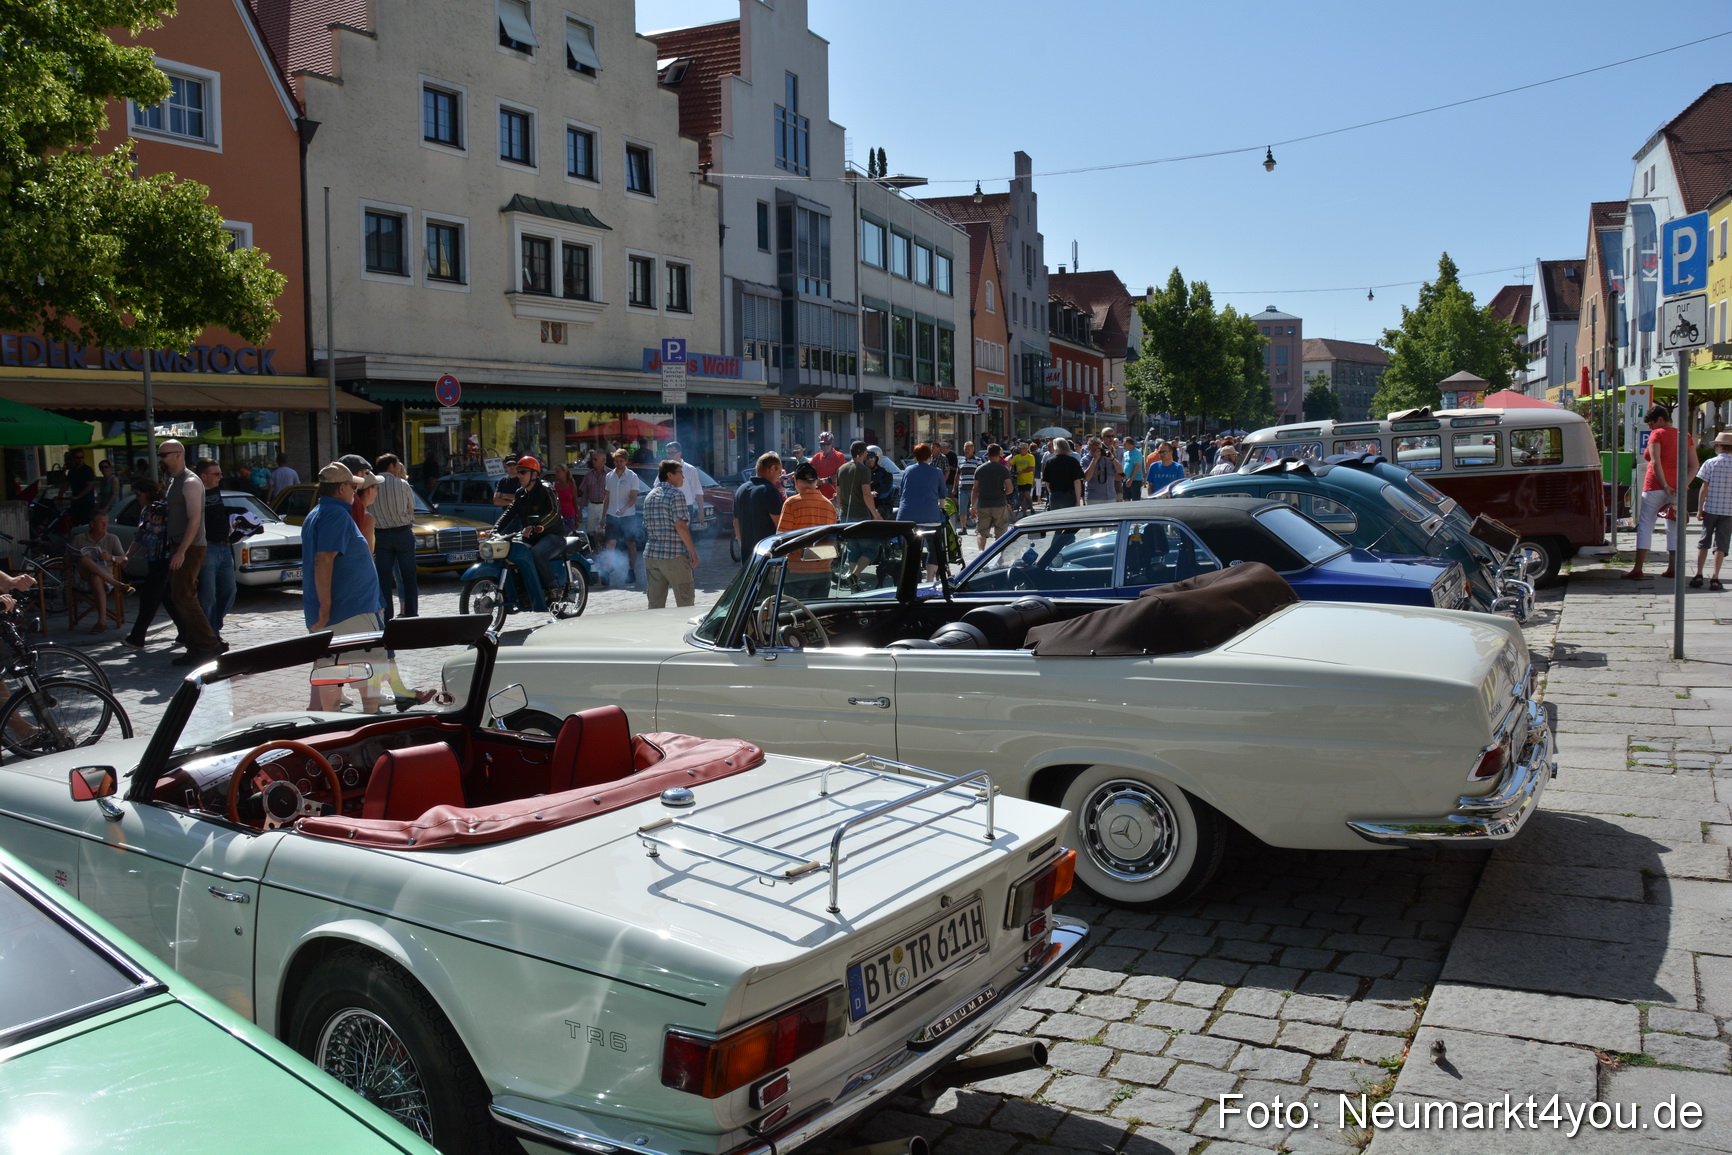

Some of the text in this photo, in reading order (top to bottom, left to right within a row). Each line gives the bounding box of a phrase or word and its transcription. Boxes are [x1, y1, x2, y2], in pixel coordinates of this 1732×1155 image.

[1641, 242, 1658, 282] K&L
[1673, 226, 1698, 286] P
[1676, 302, 1691, 314] nur
[667, 341, 681, 360] P
[702, 355, 740, 377] Wölfl
[789, 397, 819, 409] ESPRIT
[864, 905, 984, 1005] BT TR 611H
[855, 997, 862, 1010] D
[935, 989, 993, 1032] TRIUMPH
[564, 1019, 628, 1053] TR6
